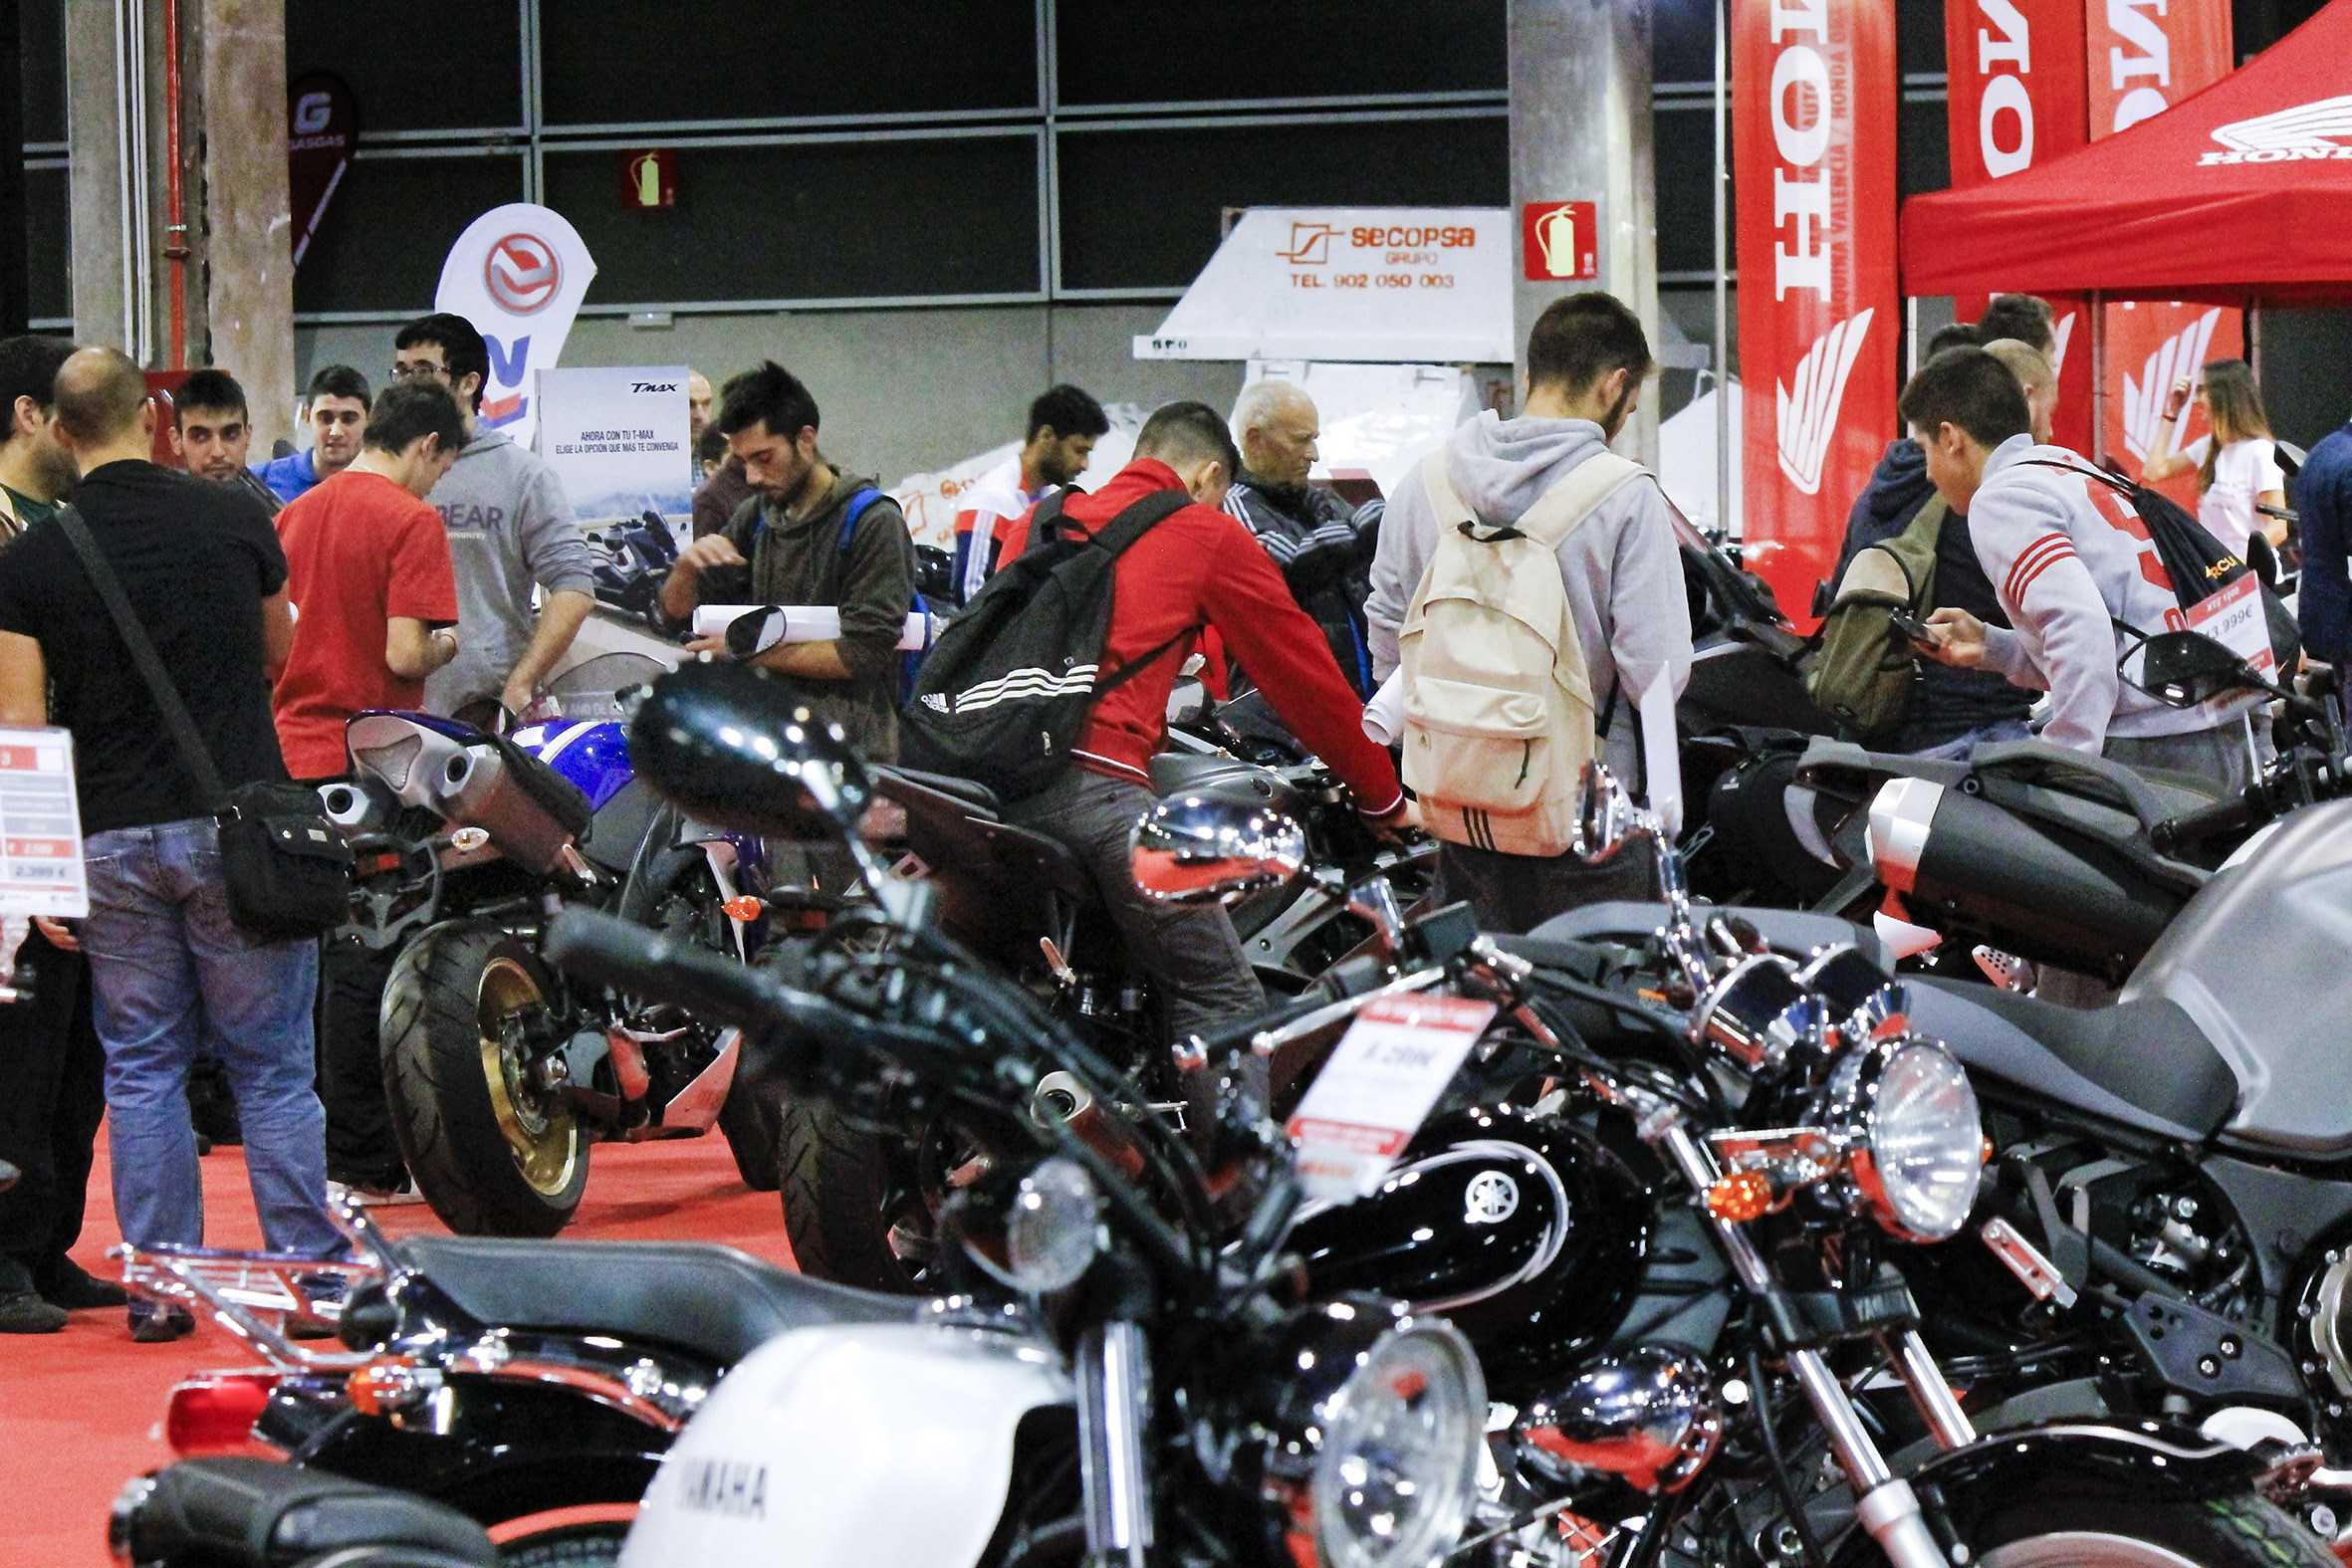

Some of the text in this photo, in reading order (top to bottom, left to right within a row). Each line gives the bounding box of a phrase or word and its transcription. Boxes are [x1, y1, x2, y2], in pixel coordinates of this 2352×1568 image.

[1385, 251, 1438, 266] GRUPO
[1334, 275, 1369, 288] 902
[1376, 275, 1412, 288] 050
[1419, 275, 1455, 288] 003
[581, 429, 654, 441] AHORA CON TU T-MAX
[556, 444, 574, 455] ELIGE
